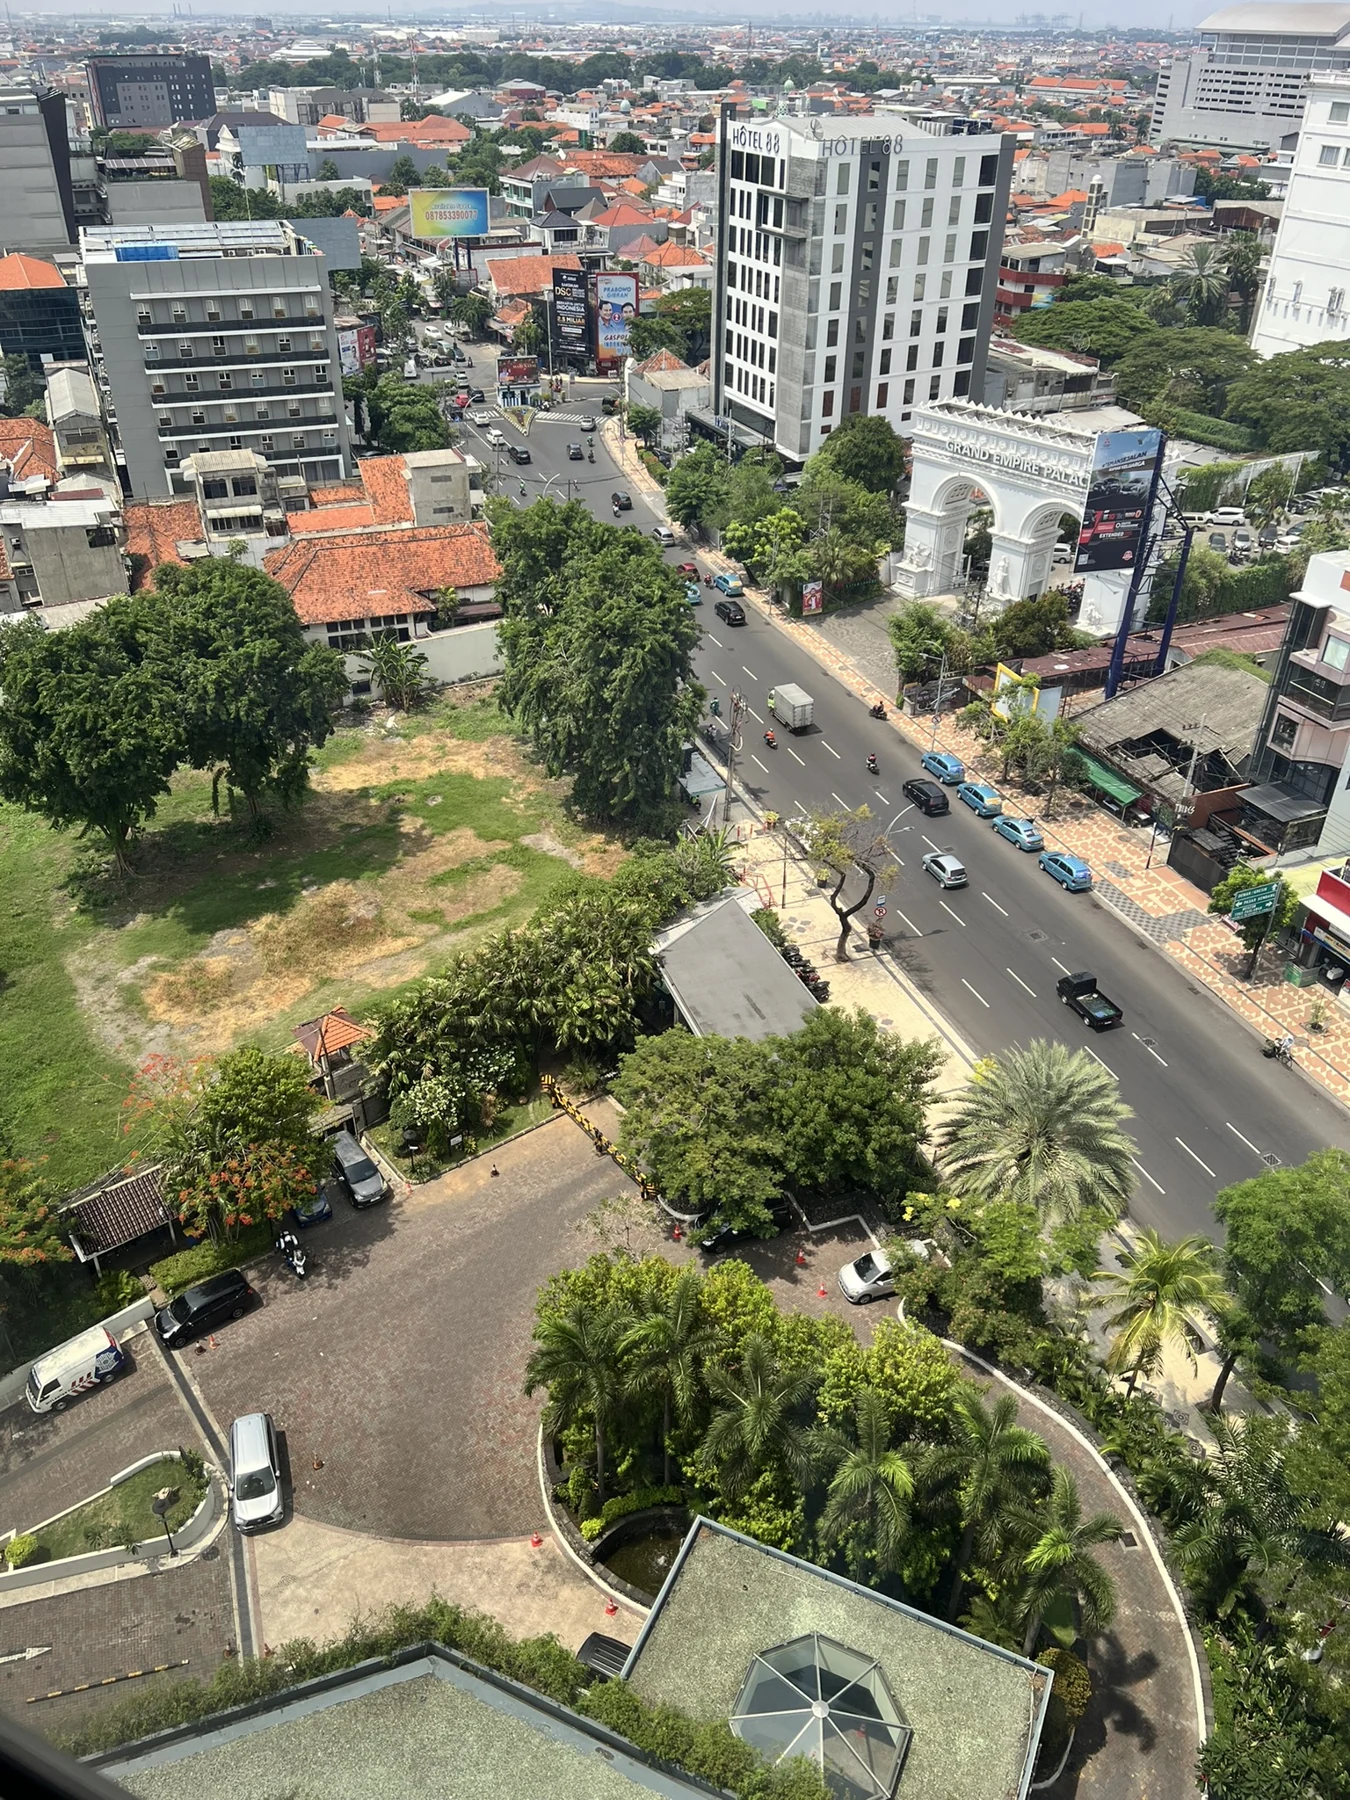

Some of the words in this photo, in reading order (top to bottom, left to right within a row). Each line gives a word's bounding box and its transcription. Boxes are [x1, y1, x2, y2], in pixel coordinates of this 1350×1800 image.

[732, 125, 763, 150] HÔTEL
[766, 132, 780, 154] 88
[822, 134, 875, 157] HÔTEL
[882, 134, 903, 155] 88
[425, 210, 478, 221] 087853390077
[555, 286, 572, 297] DSC
[556, 305, 585, 313] INDONESIA
[945, 439, 990, 461] GRAND
[992, 451, 1041, 475] EMPIRE
[1043, 465, 1090, 488] PALAC
